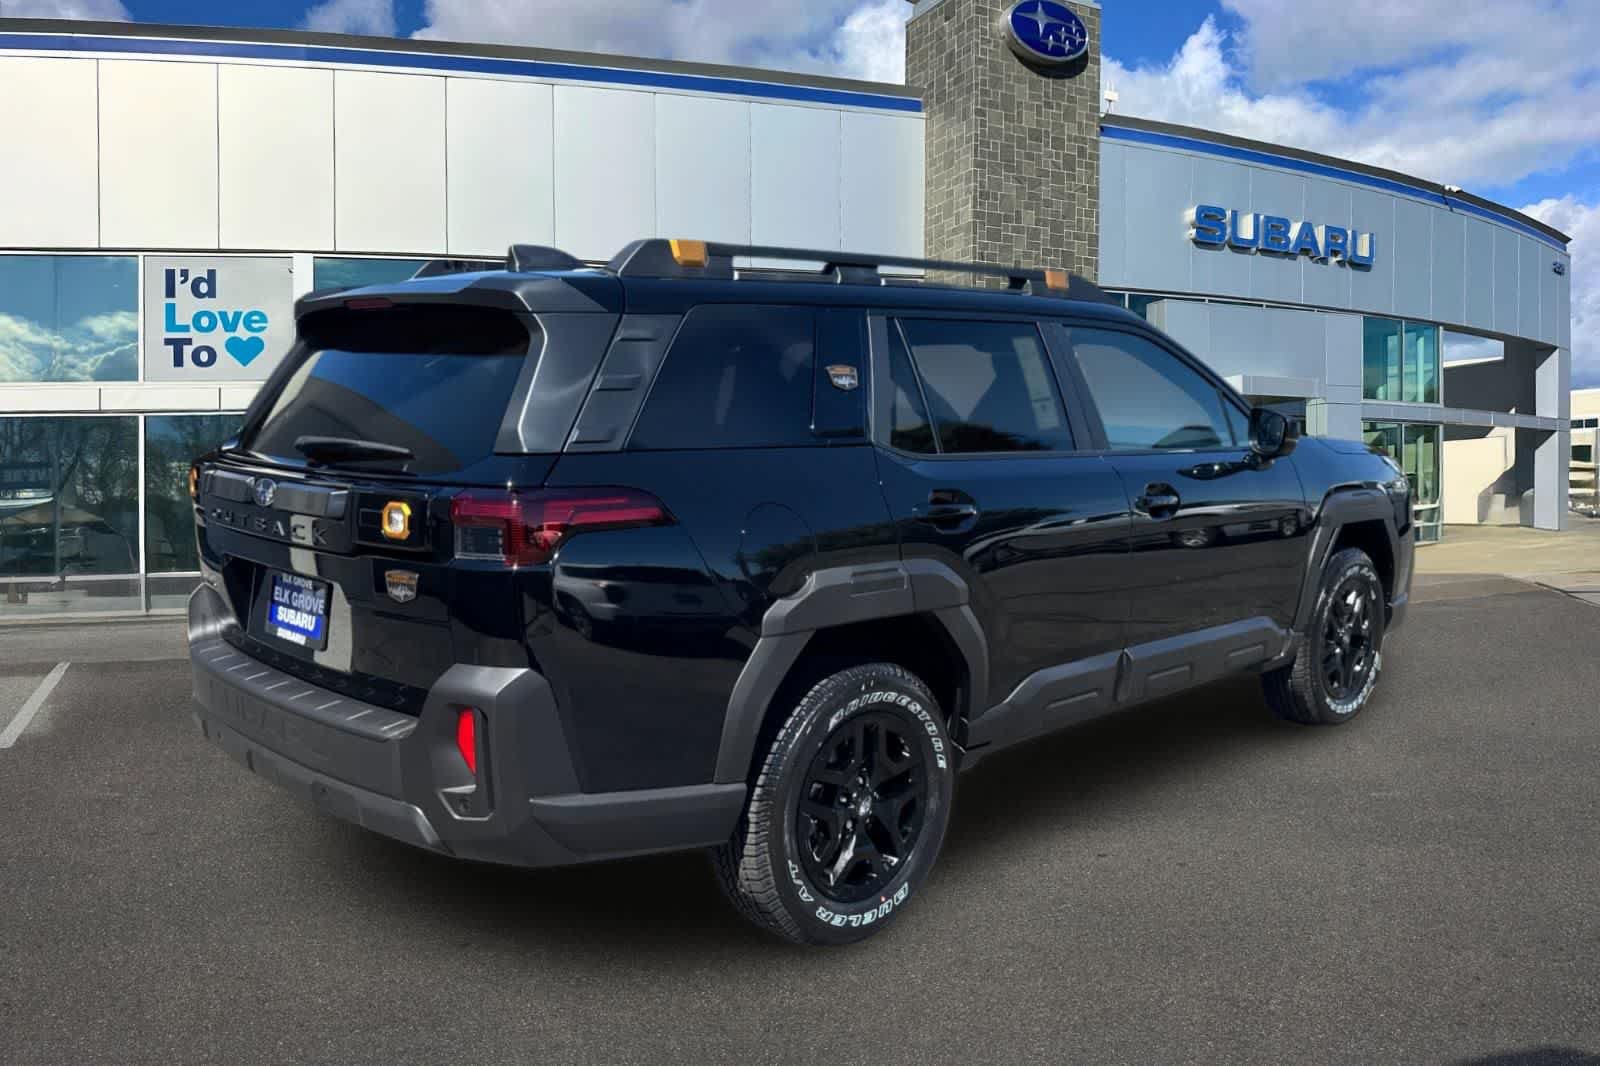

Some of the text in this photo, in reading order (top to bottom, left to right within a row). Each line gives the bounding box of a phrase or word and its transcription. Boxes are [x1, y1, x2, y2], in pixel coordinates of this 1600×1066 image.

[1191, 204, 1376, 268] SUBARU
[165, 302, 268, 333] Love
[164, 337, 217, 367] To
[274, 585, 325, 615] ELK GROVE
[277, 605, 316, 632] SUBARU
